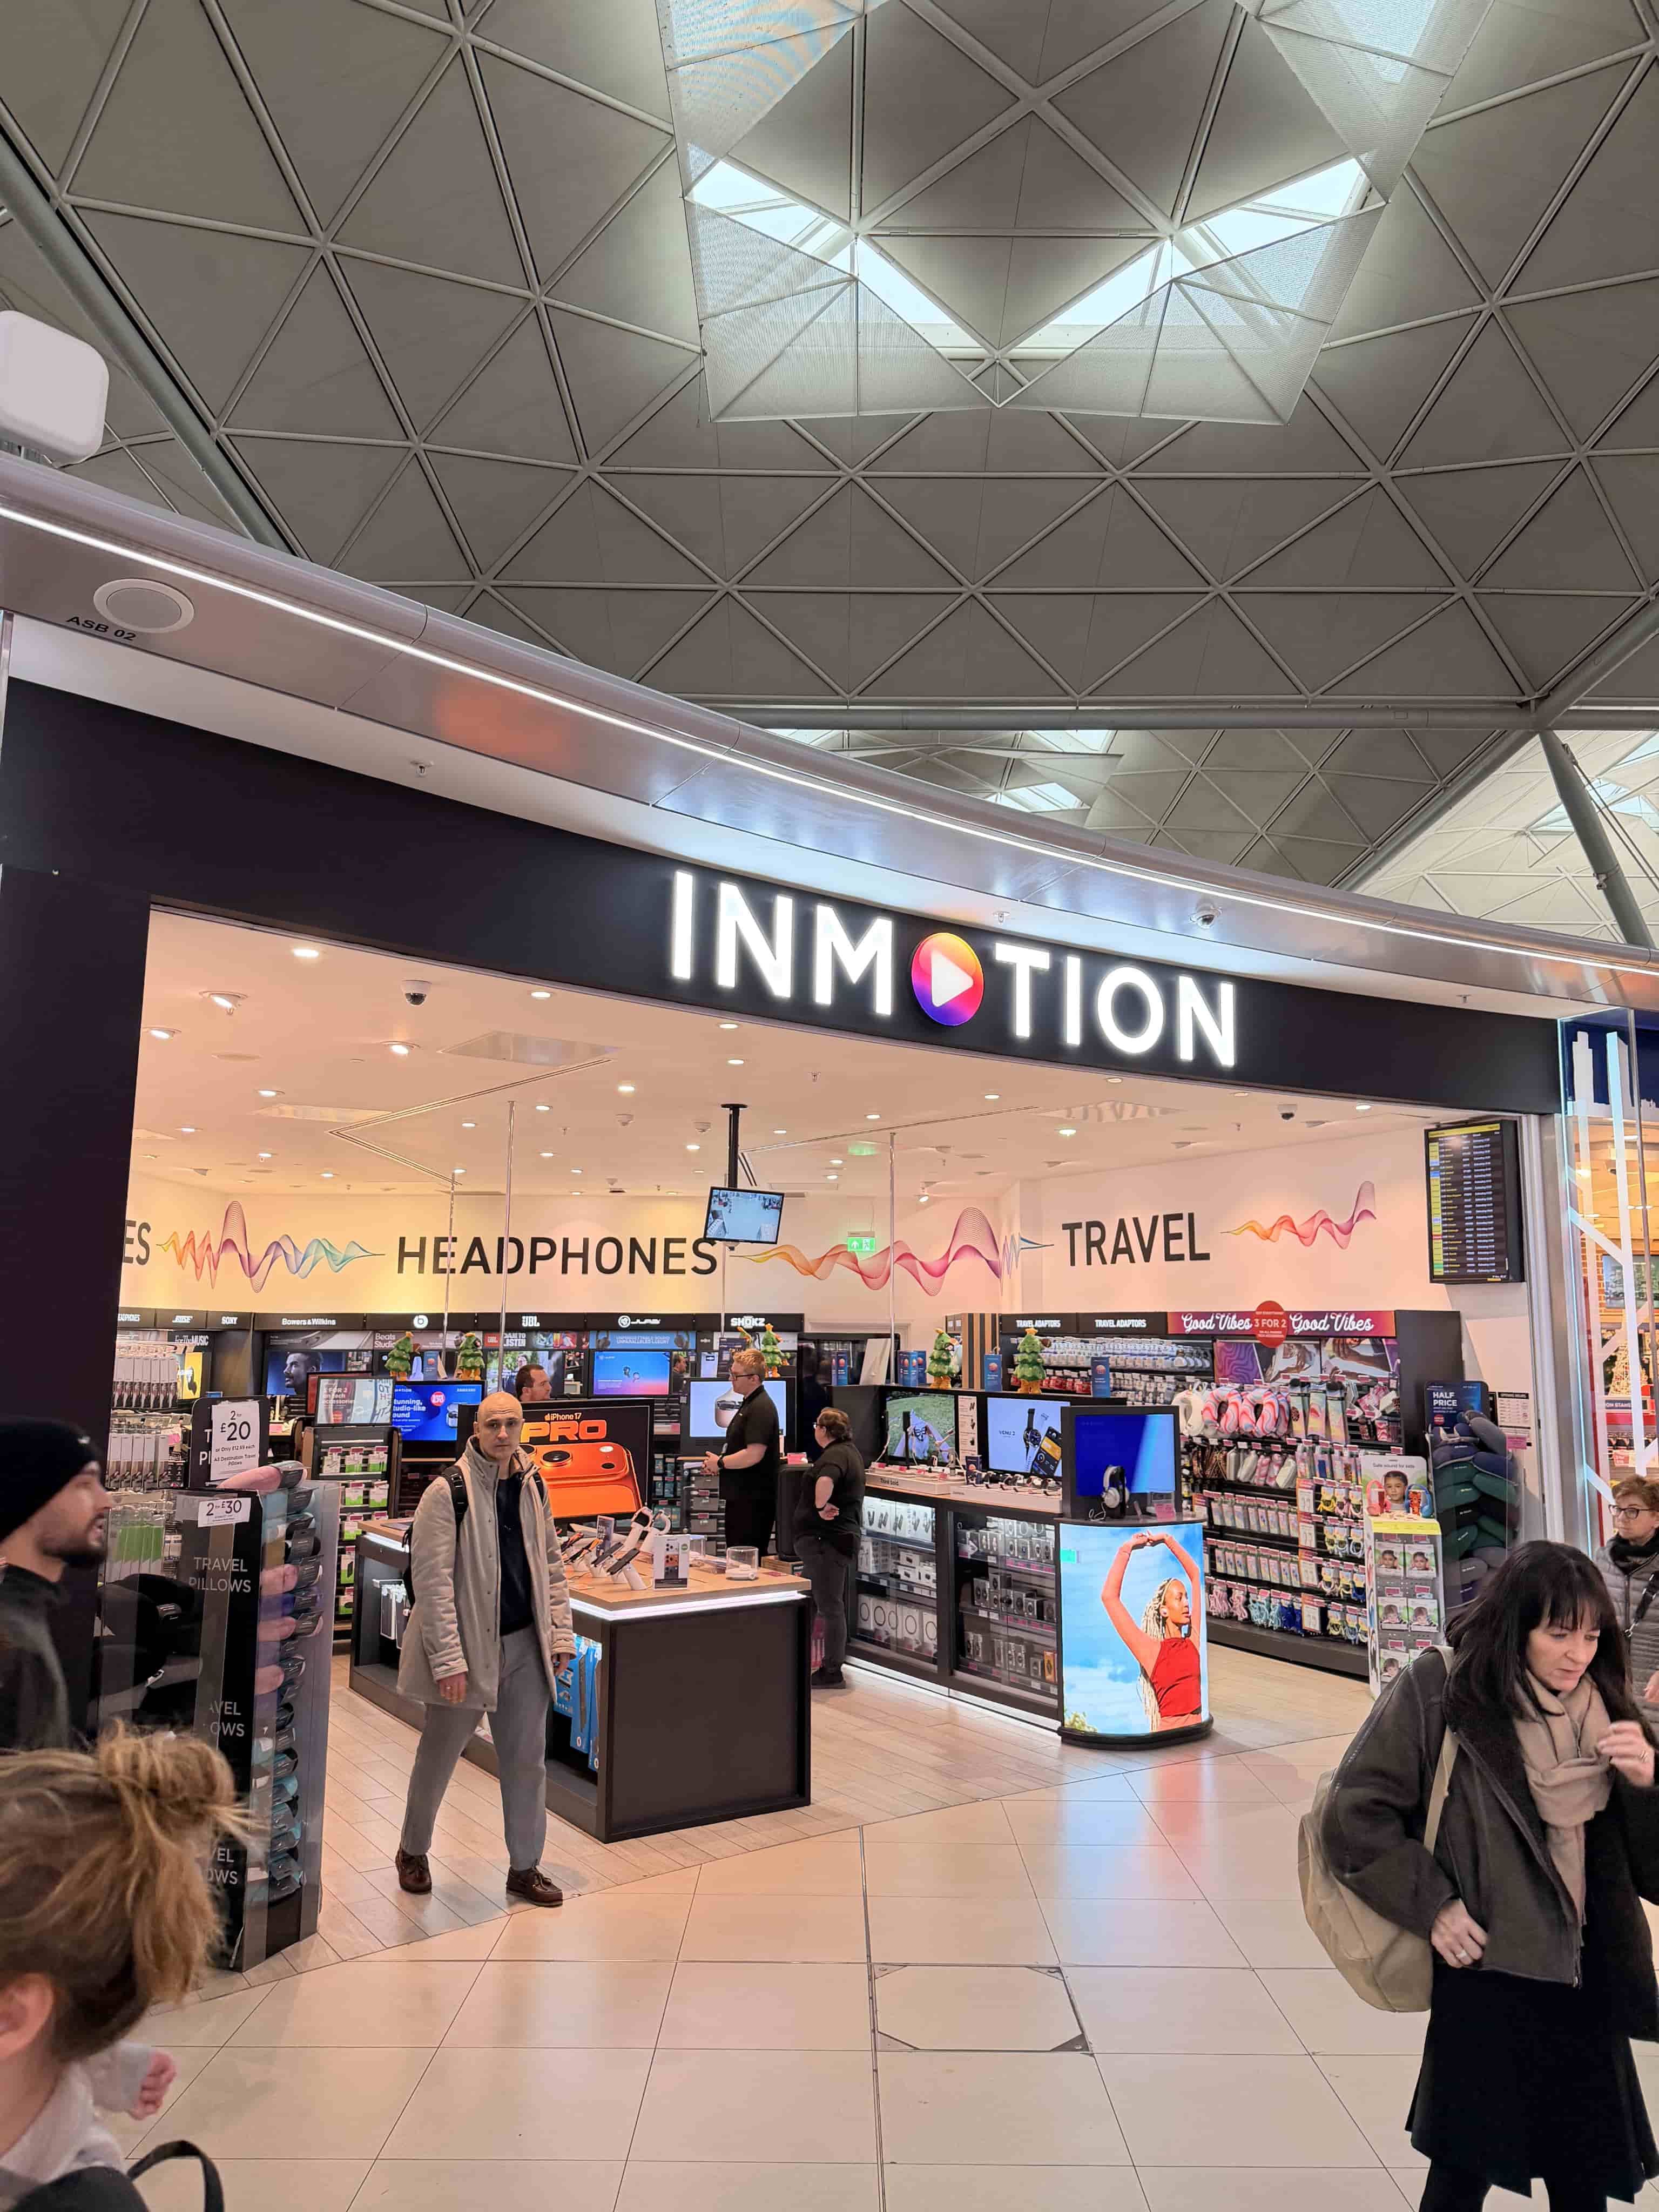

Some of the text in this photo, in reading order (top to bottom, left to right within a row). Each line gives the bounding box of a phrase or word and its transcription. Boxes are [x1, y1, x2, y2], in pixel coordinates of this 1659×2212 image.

[65, 616, 137, 641] ASB 02
[671, 868, 1237, 1068] INMOTION
[1062, 1212, 1210, 1266] TRAVEL
[397, 1237, 718, 1275] HEADPHONES
[221, 1316, 238, 1324] SONY
[730, 1316, 765, 1328] SHOKZ
[1016, 1319, 1061, 1328] TRAVEL ADAPTORS
[1095, 1319, 1147, 1328] TRAVEL ADAPTORS
[1182, 1312, 1252, 1334] Good Vibes
[1254, 1319, 1287, 1327] 3 FOR 2
[1289, 1312, 1374, 1334] Good Vibes
[230, 1410, 236, 1420] 2
[220, 1421, 251, 1441] £20
[520, 1420, 607, 1443] PRO
[206, 1503, 214, 1516] 2
[221, 1500, 242, 1514] £30
[194, 1556, 248, 1573] TRAVEL
[189, 1576, 251, 1593] PILLOWS
